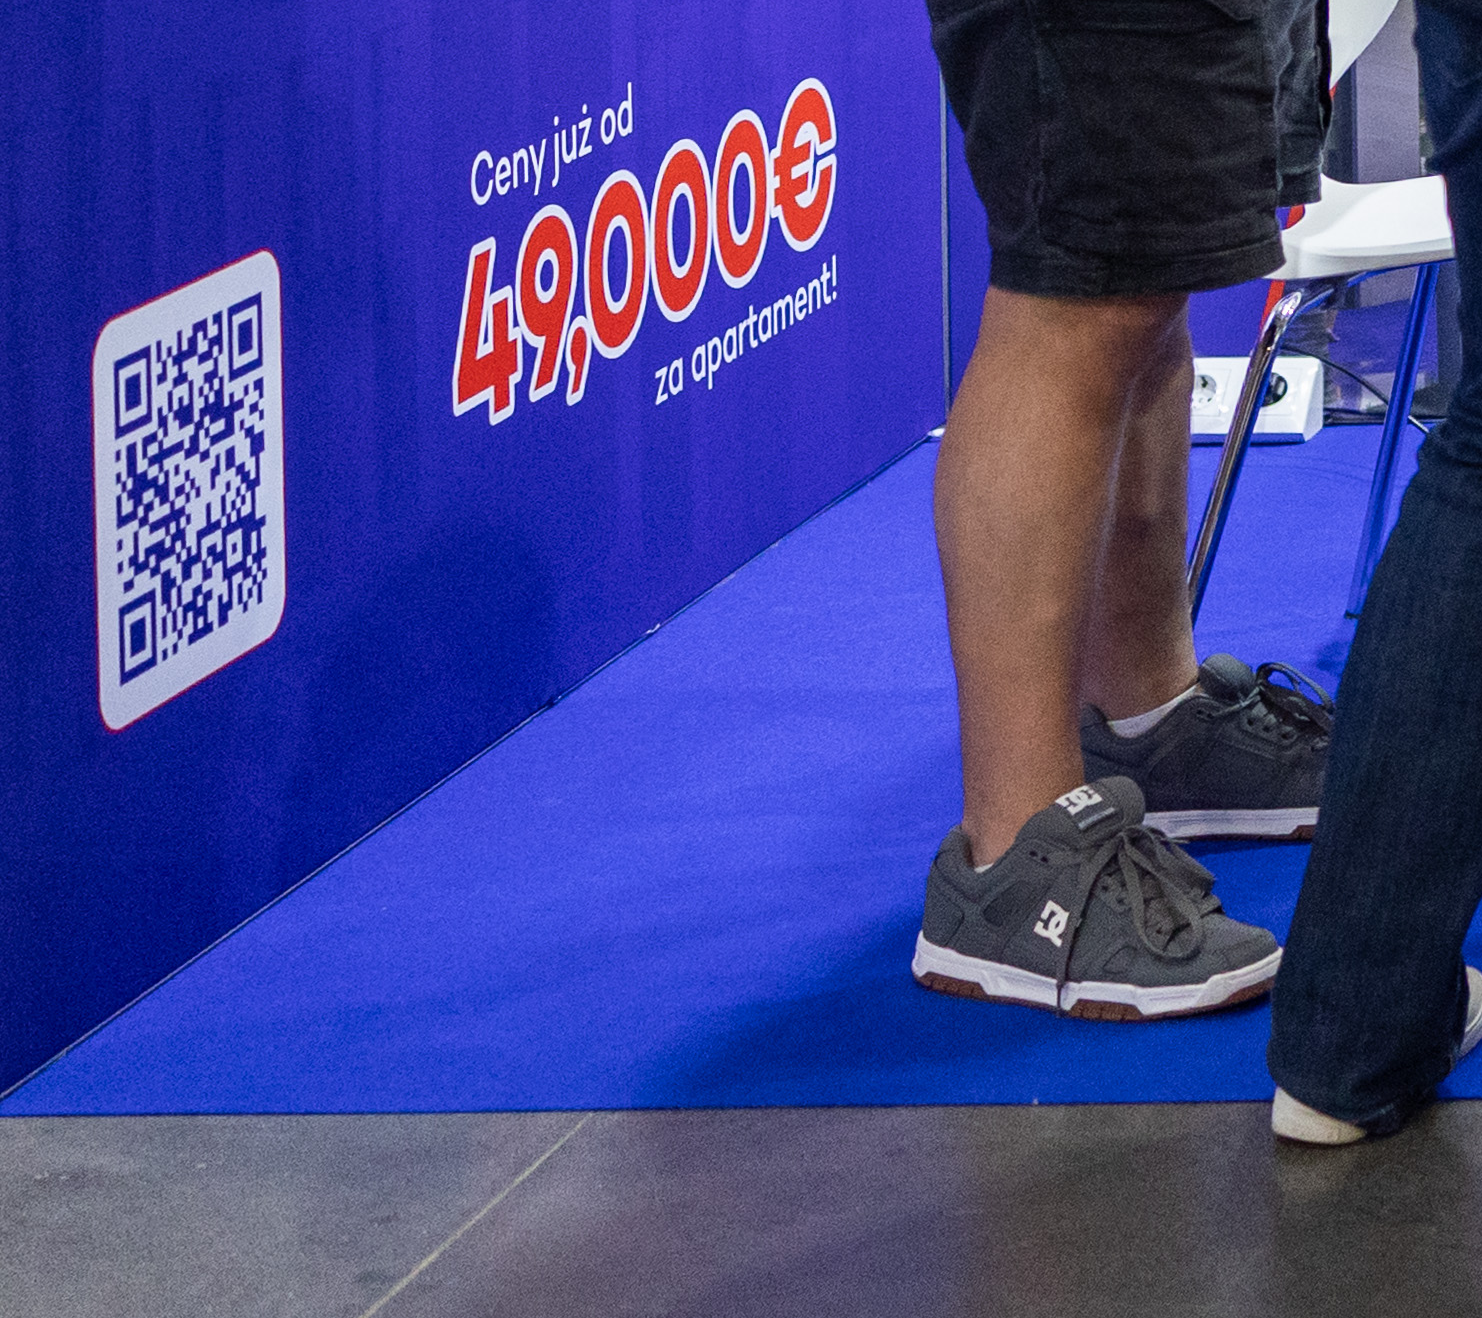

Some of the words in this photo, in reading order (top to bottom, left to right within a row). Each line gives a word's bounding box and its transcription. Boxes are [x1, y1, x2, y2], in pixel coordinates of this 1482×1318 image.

[470, 138, 547, 206] Ceny
[552, 103, 593, 188] już
[600, 81, 633, 146] od
[452, 77, 838, 425] 49,000€
[654, 357, 684, 406] za
[691, 254, 838, 391] apartament!
